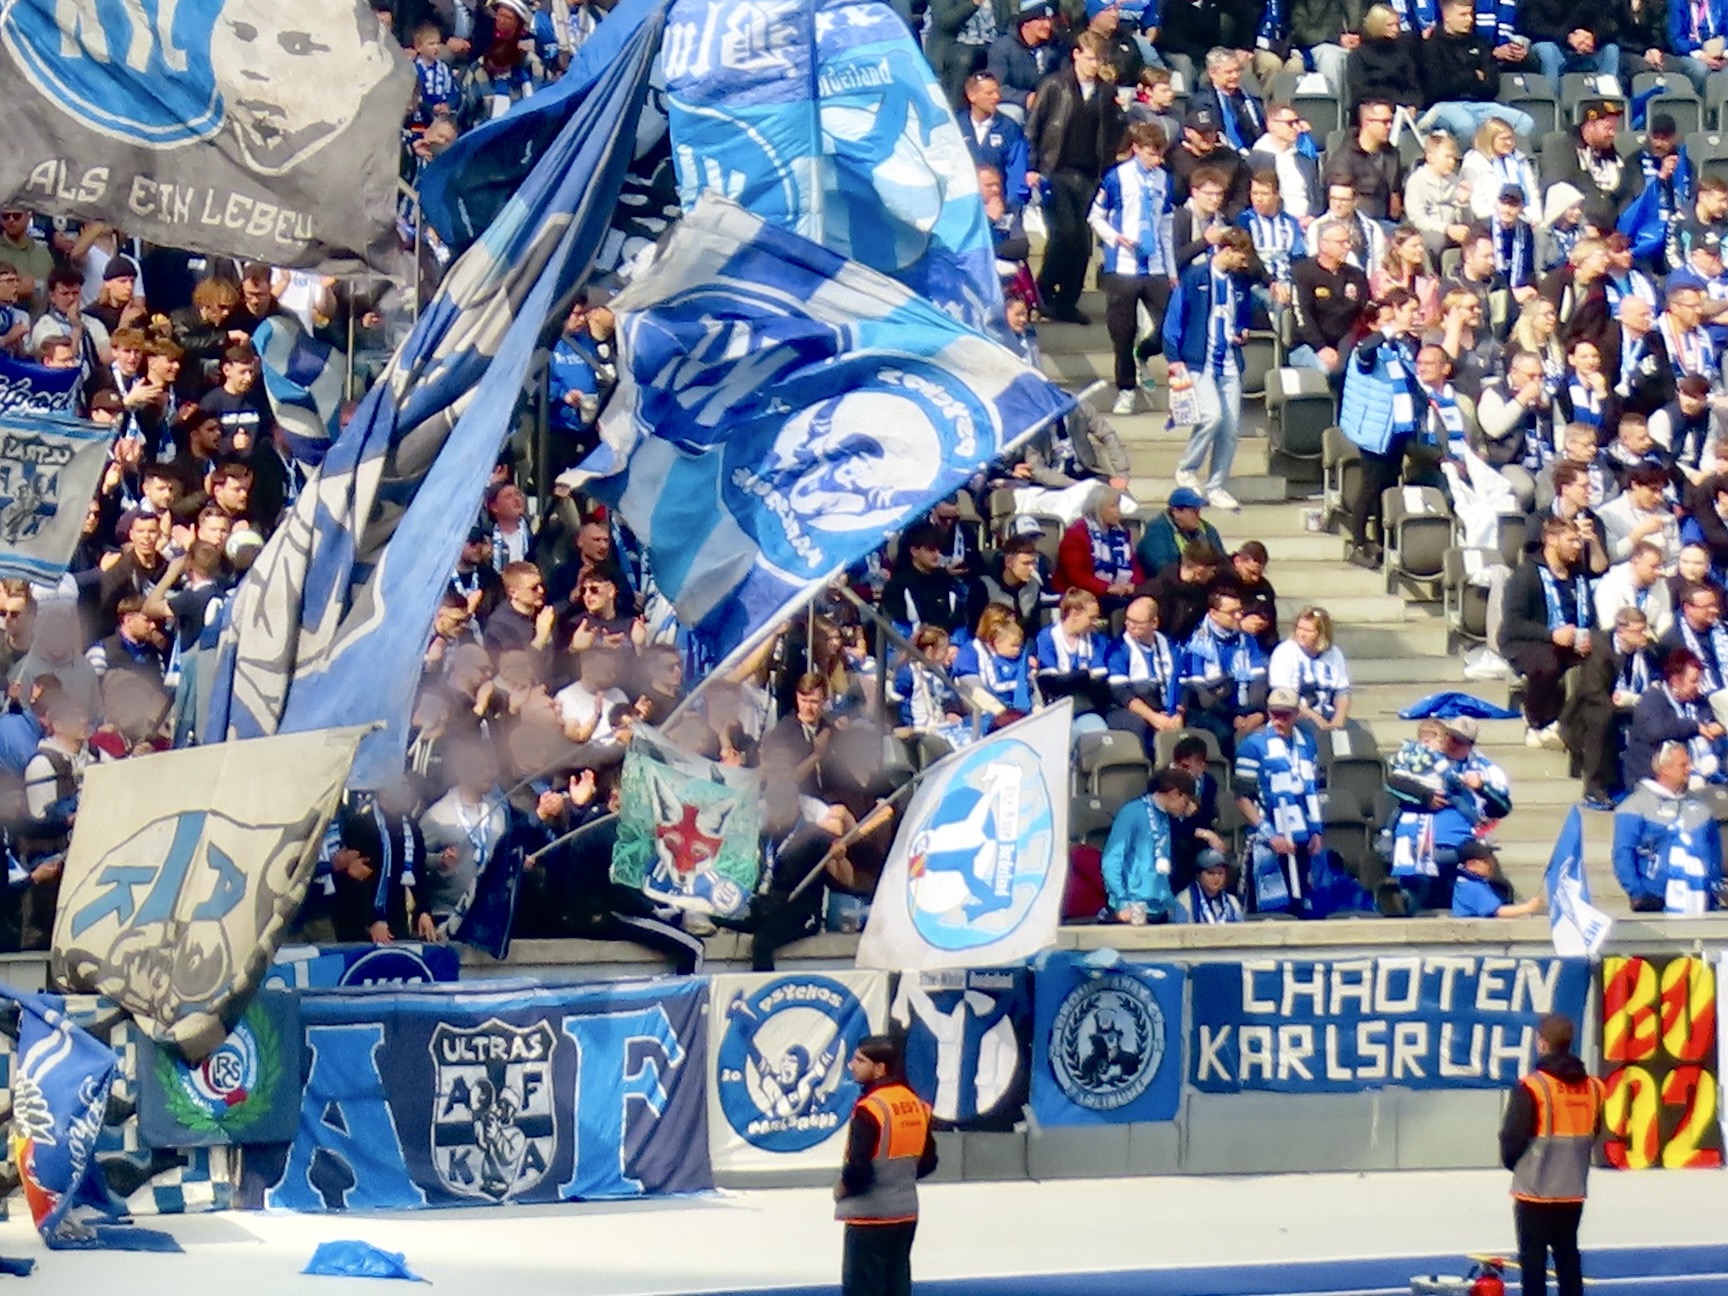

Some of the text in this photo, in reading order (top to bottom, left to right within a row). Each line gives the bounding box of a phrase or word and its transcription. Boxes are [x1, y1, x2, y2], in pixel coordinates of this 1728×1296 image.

[25, 159, 314, 246] ALS EIN LEBEN
[1242, 960, 1561, 1014] CHAOTEN
[443, 1033, 543, 1061] ULTRAS
[1198, 1024, 1537, 1079] KARLSRUH
[264, 1021, 427, 1210] A
[559, 1005, 685, 1200] F
